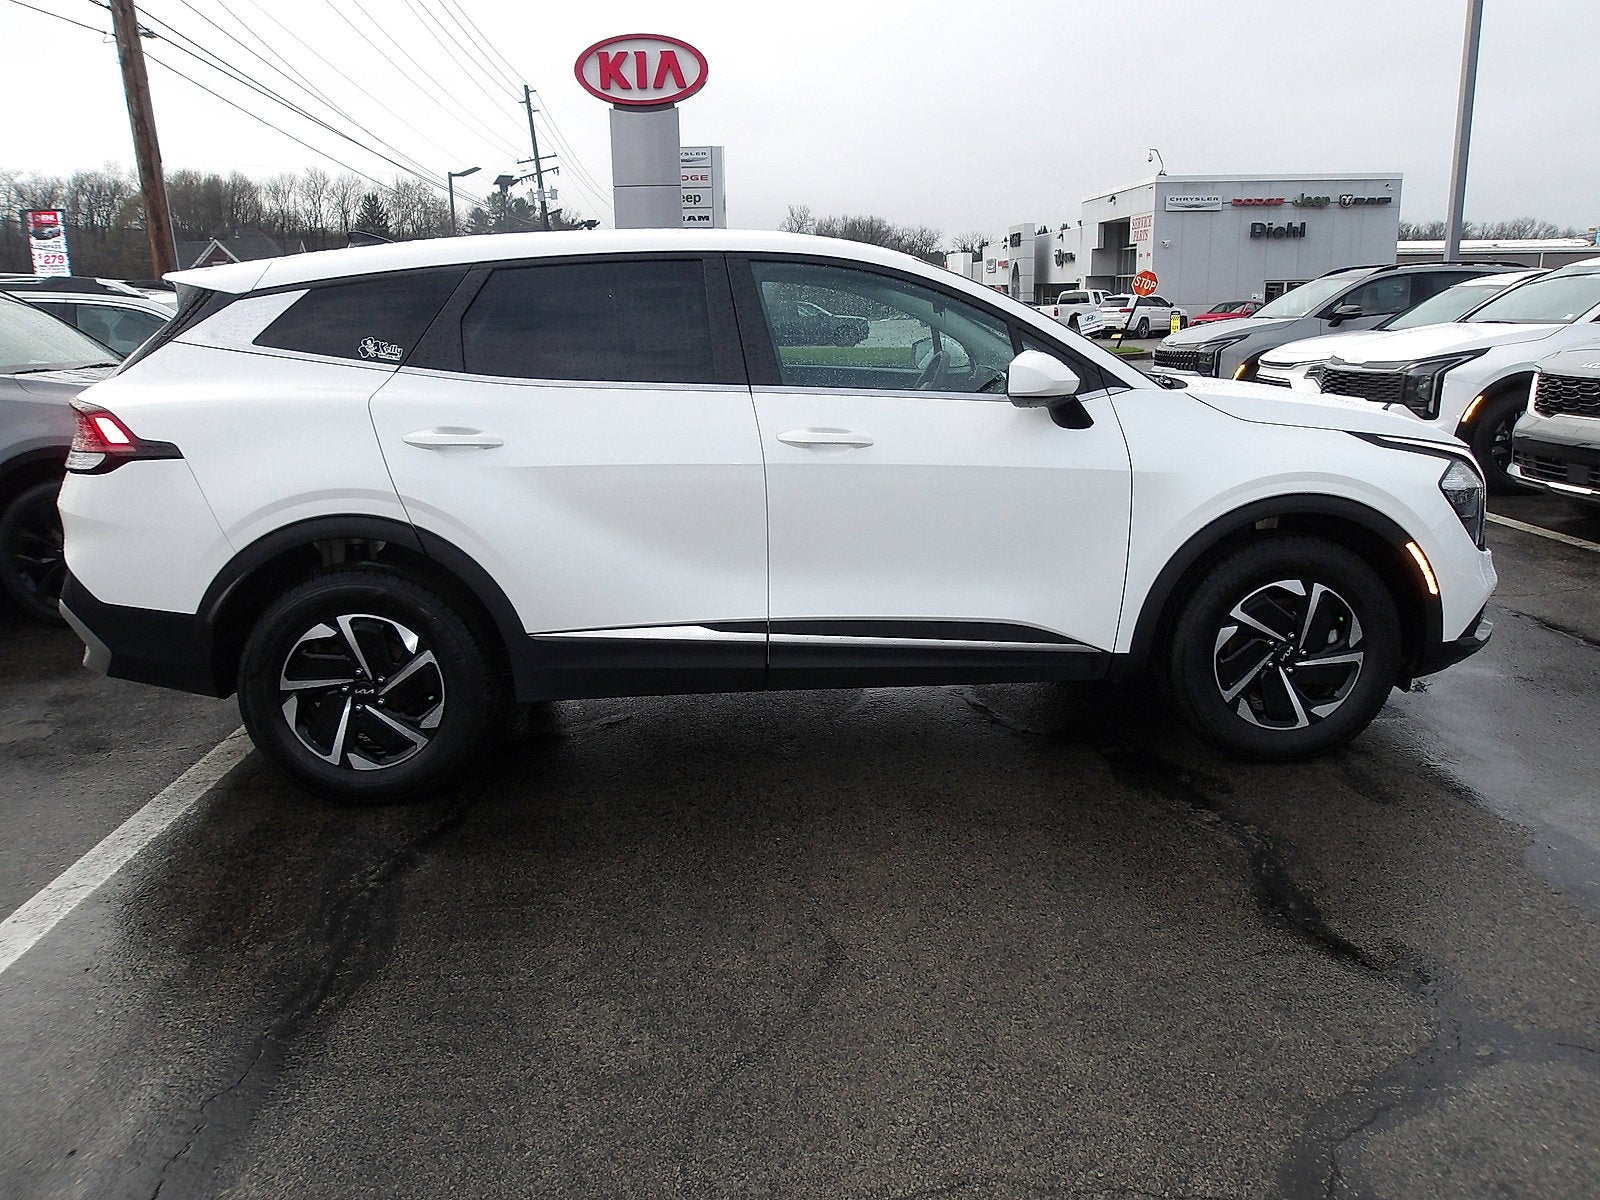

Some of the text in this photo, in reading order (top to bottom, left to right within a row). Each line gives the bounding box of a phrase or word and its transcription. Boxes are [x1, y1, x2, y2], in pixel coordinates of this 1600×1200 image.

[597, 50, 687, 89] KIA
[1232, 197, 1286, 207] DODGE
[1292, 192, 1331, 209] Jeep
[1250, 221, 1306, 239] Diehl
[43, 254, 65, 265] 279
[1134, 276, 1157, 291] STOP
